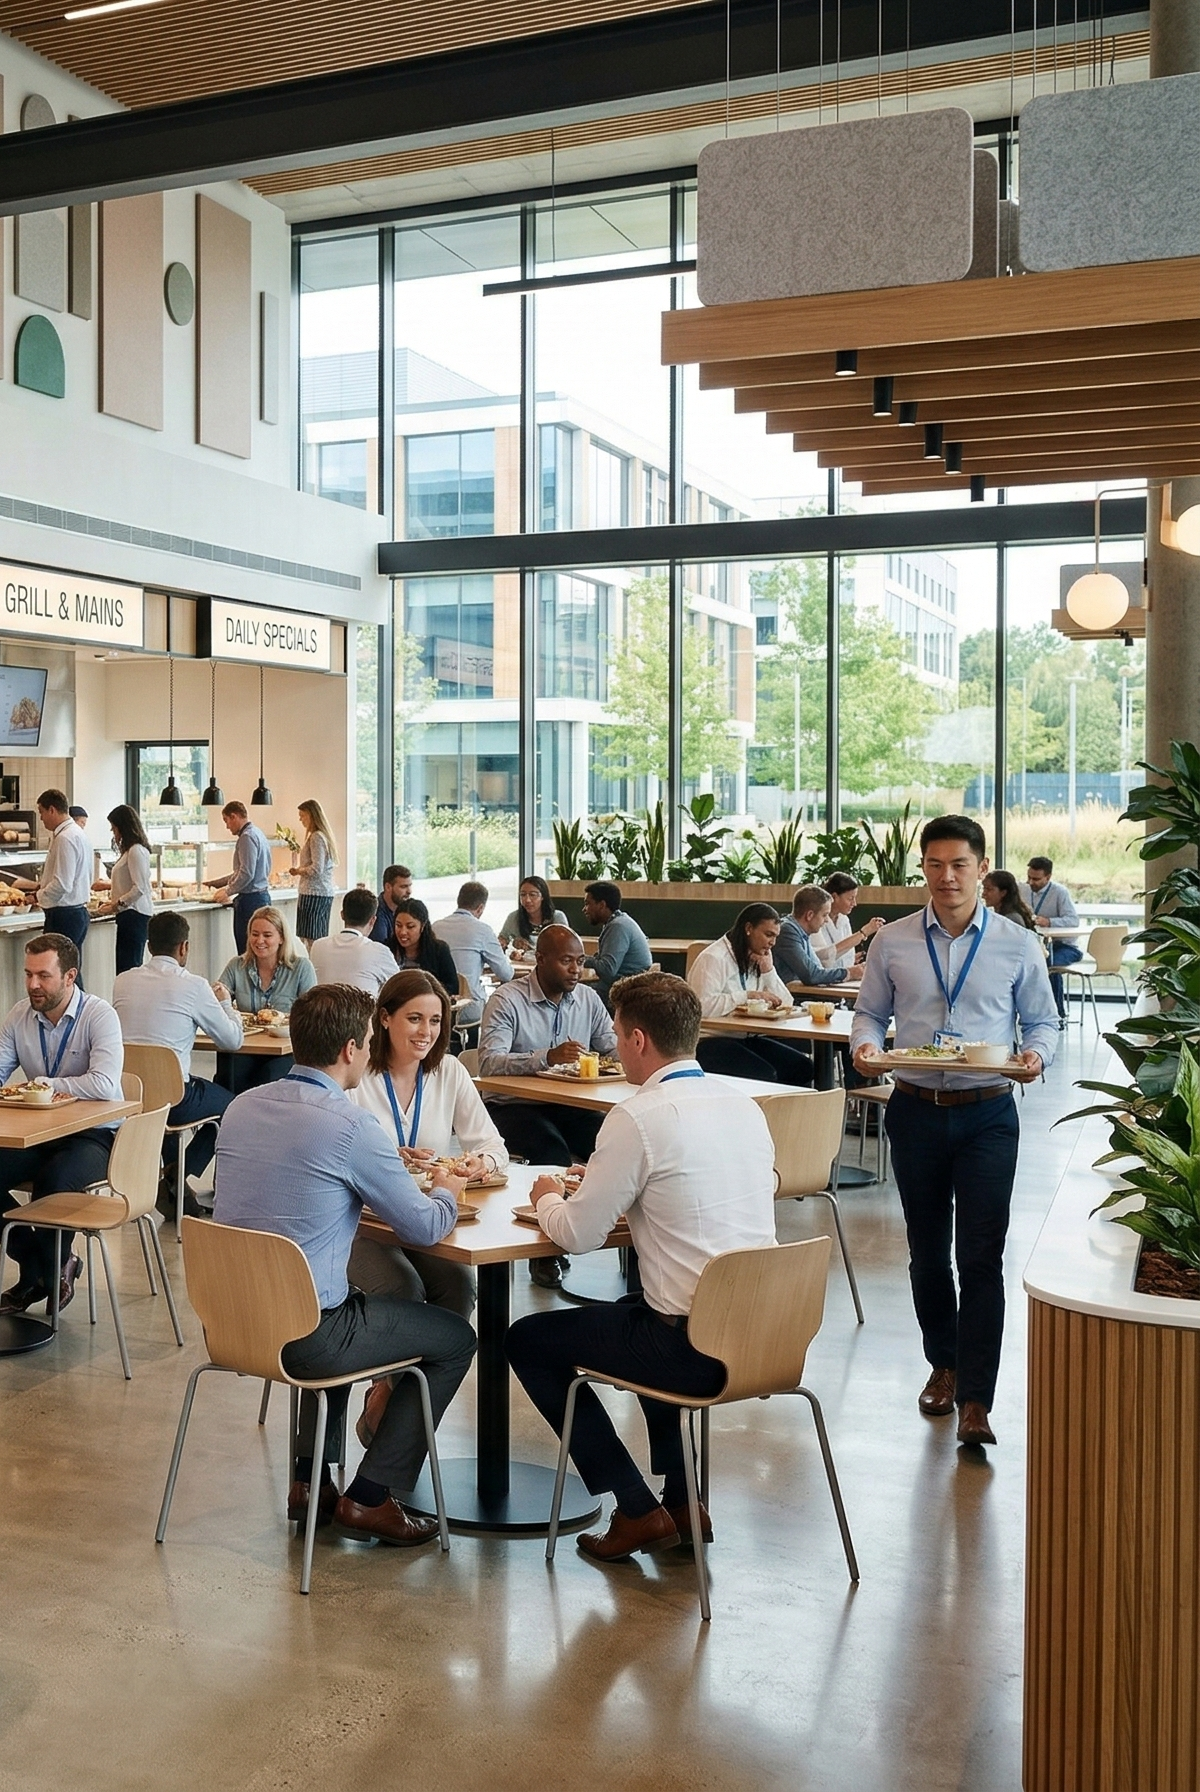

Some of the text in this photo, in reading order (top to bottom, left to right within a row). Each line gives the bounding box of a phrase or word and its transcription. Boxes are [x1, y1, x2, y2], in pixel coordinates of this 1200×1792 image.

[5, 582, 125, 628] GRILL & MAINS
[226, 617, 318, 654] DAILY SPECIALS
